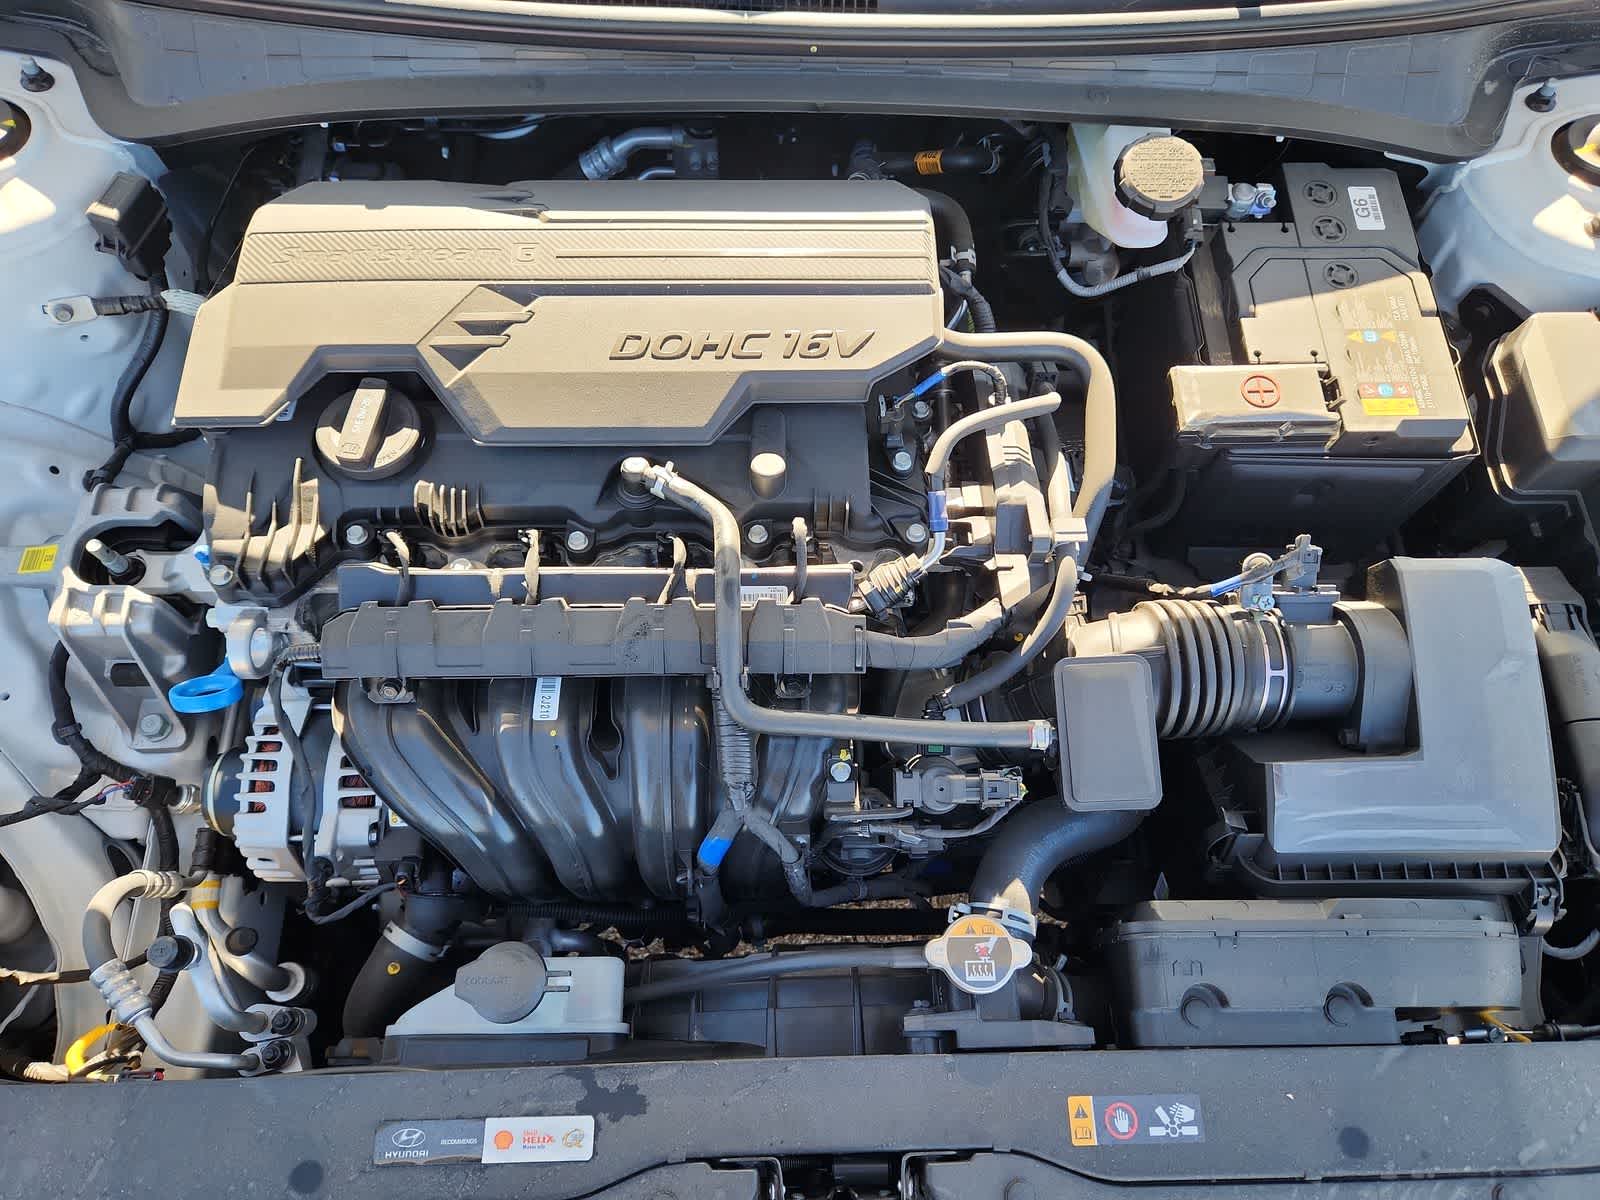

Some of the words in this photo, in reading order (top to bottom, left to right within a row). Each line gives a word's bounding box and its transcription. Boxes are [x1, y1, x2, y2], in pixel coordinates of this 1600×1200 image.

[1353, 199, 1370, 217] G6
[271, 242, 503, 265] Smartstream
[514, 243, 538, 263] G
[608, 329, 771, 361] DOHC
[782, 329, 876, 360] 16V
[523, 1135, 555, 1144] HELIX
[385, 1150, 429, 1159] HYUNDAI
